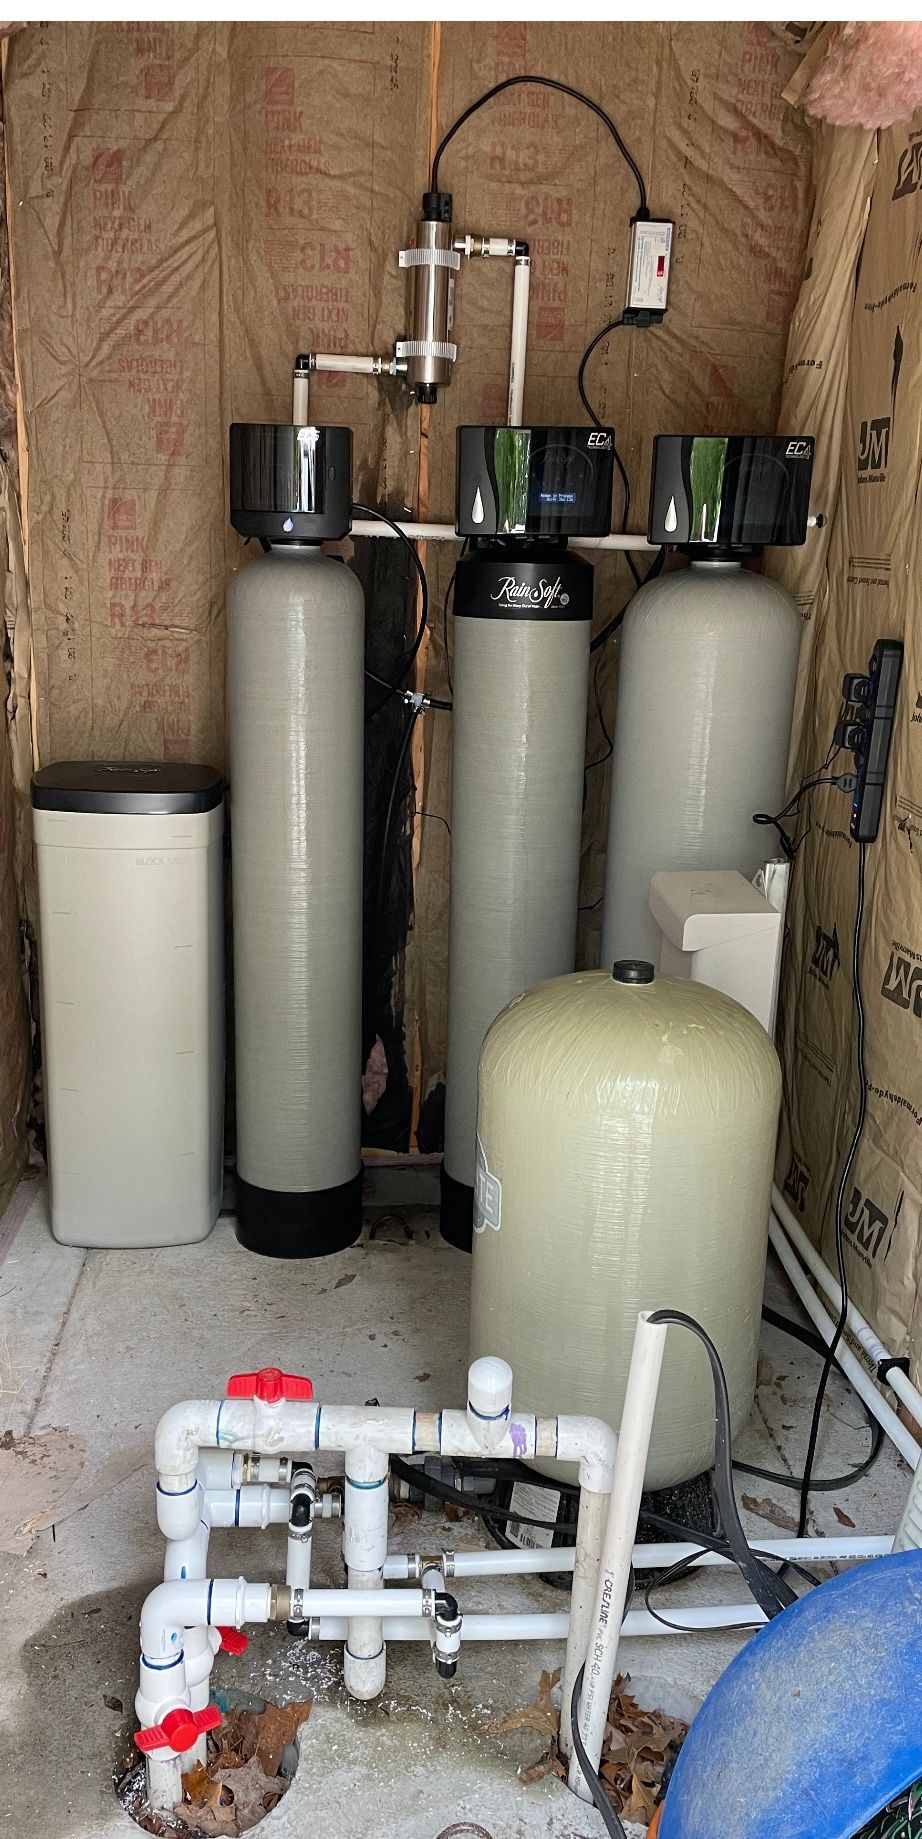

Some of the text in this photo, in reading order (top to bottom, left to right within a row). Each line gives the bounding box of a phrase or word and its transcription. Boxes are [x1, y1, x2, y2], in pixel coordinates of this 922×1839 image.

[490, 142, 541, 174] R13
[264, 187, 317, 222] R13
[524, 196, 573, 228] R13
[299, 241, 351, 275] R13
[292, 304, 349, 324] NEXT GEN
[132, 318, 185, 348] R13
[587, 432, 612, 450] EC4
[785, 441, 812, 460] EC4
[857, 417, 891, 471] JM
[108, 534, 146, 554] PINK
[109, 601, 156, 629] R13
[144, 647, 190, 674] R13
[844, 1186, 889, 1259] JM
[593, 1641, 604, 1663] SCH
